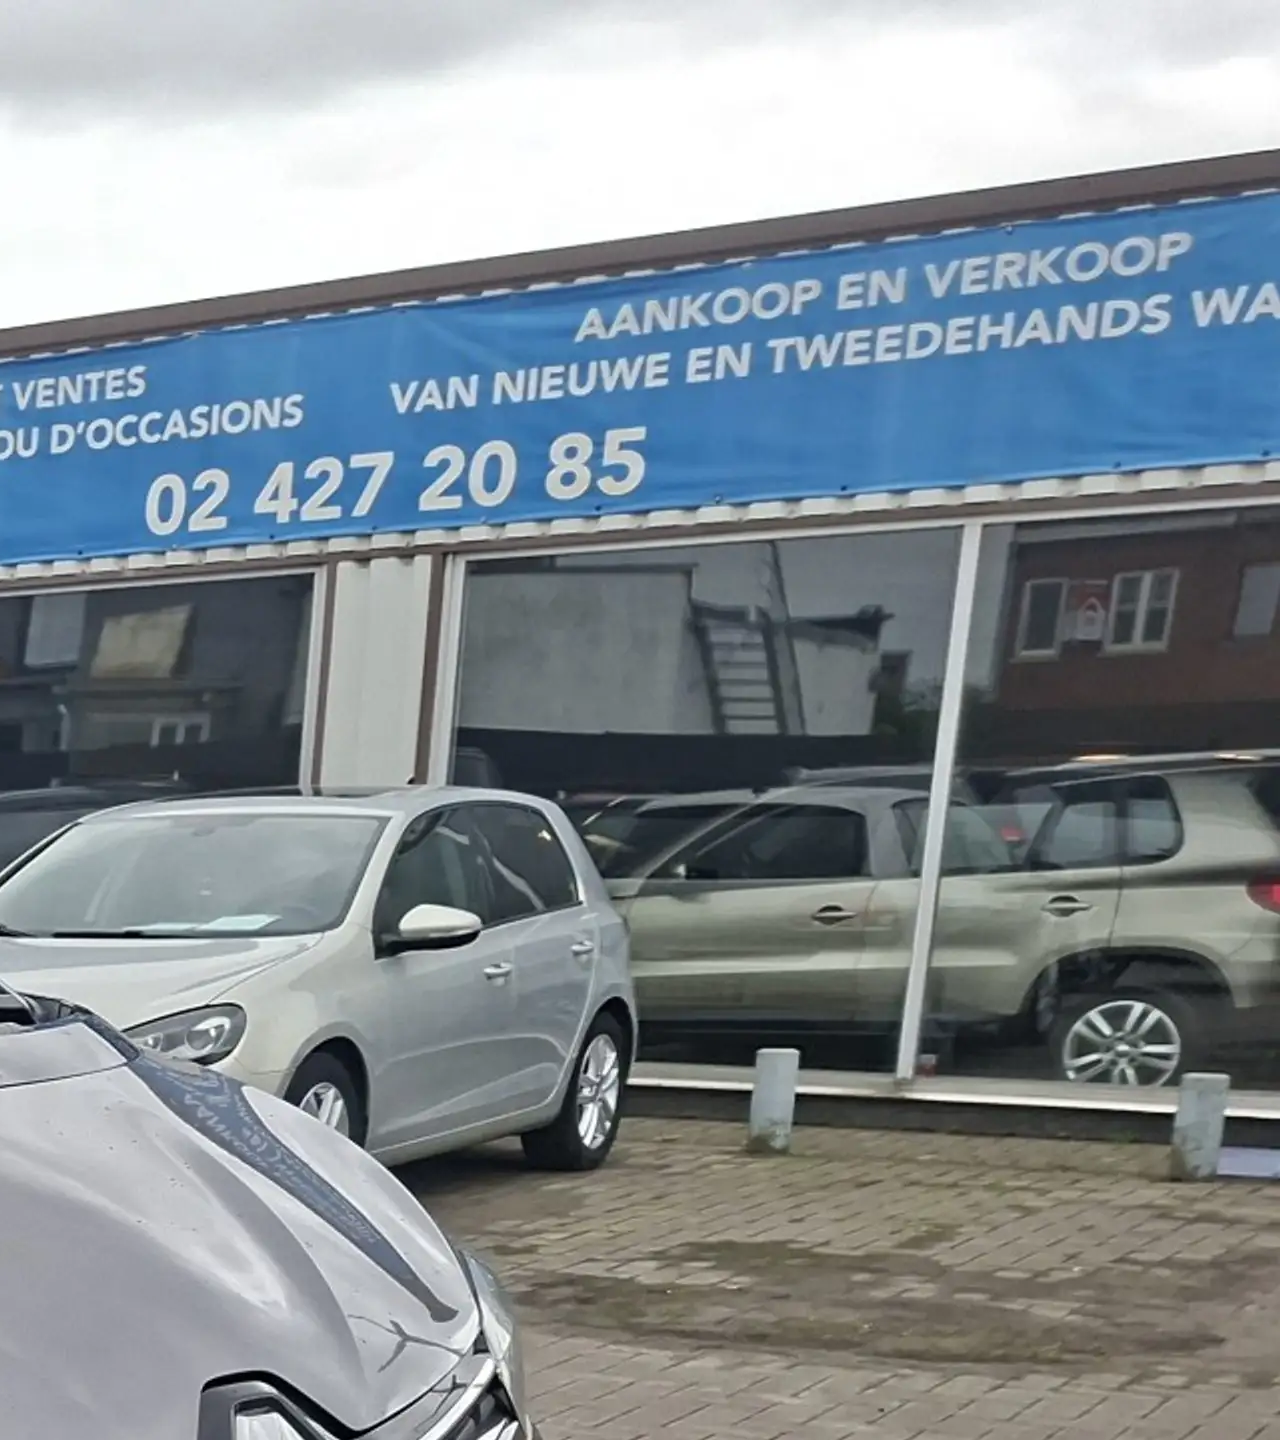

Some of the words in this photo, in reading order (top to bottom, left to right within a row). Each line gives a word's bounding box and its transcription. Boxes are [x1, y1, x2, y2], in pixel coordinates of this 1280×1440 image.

[574, 278, 822, 343] AANKOOP
[836, 267, 908, 311] EN
[924, 231, 1193, 299] VERKOOP
[12, 365, 147, 410] VENTES
[389, 374, 479, 414] VAN
[492, 352, 671, 405] NIEUWE
[685, 342, 753, 384] EN
[766, 293, 1173, 374] TWEEDEHANDS
[49, 393, 304, 455] D'OCCASIONS
[144, 467, 231, 536] 02
[253, 451, 395, 525] 427
[417, 439, 520, 513] 20
[544, 426, 647, 501] 85
